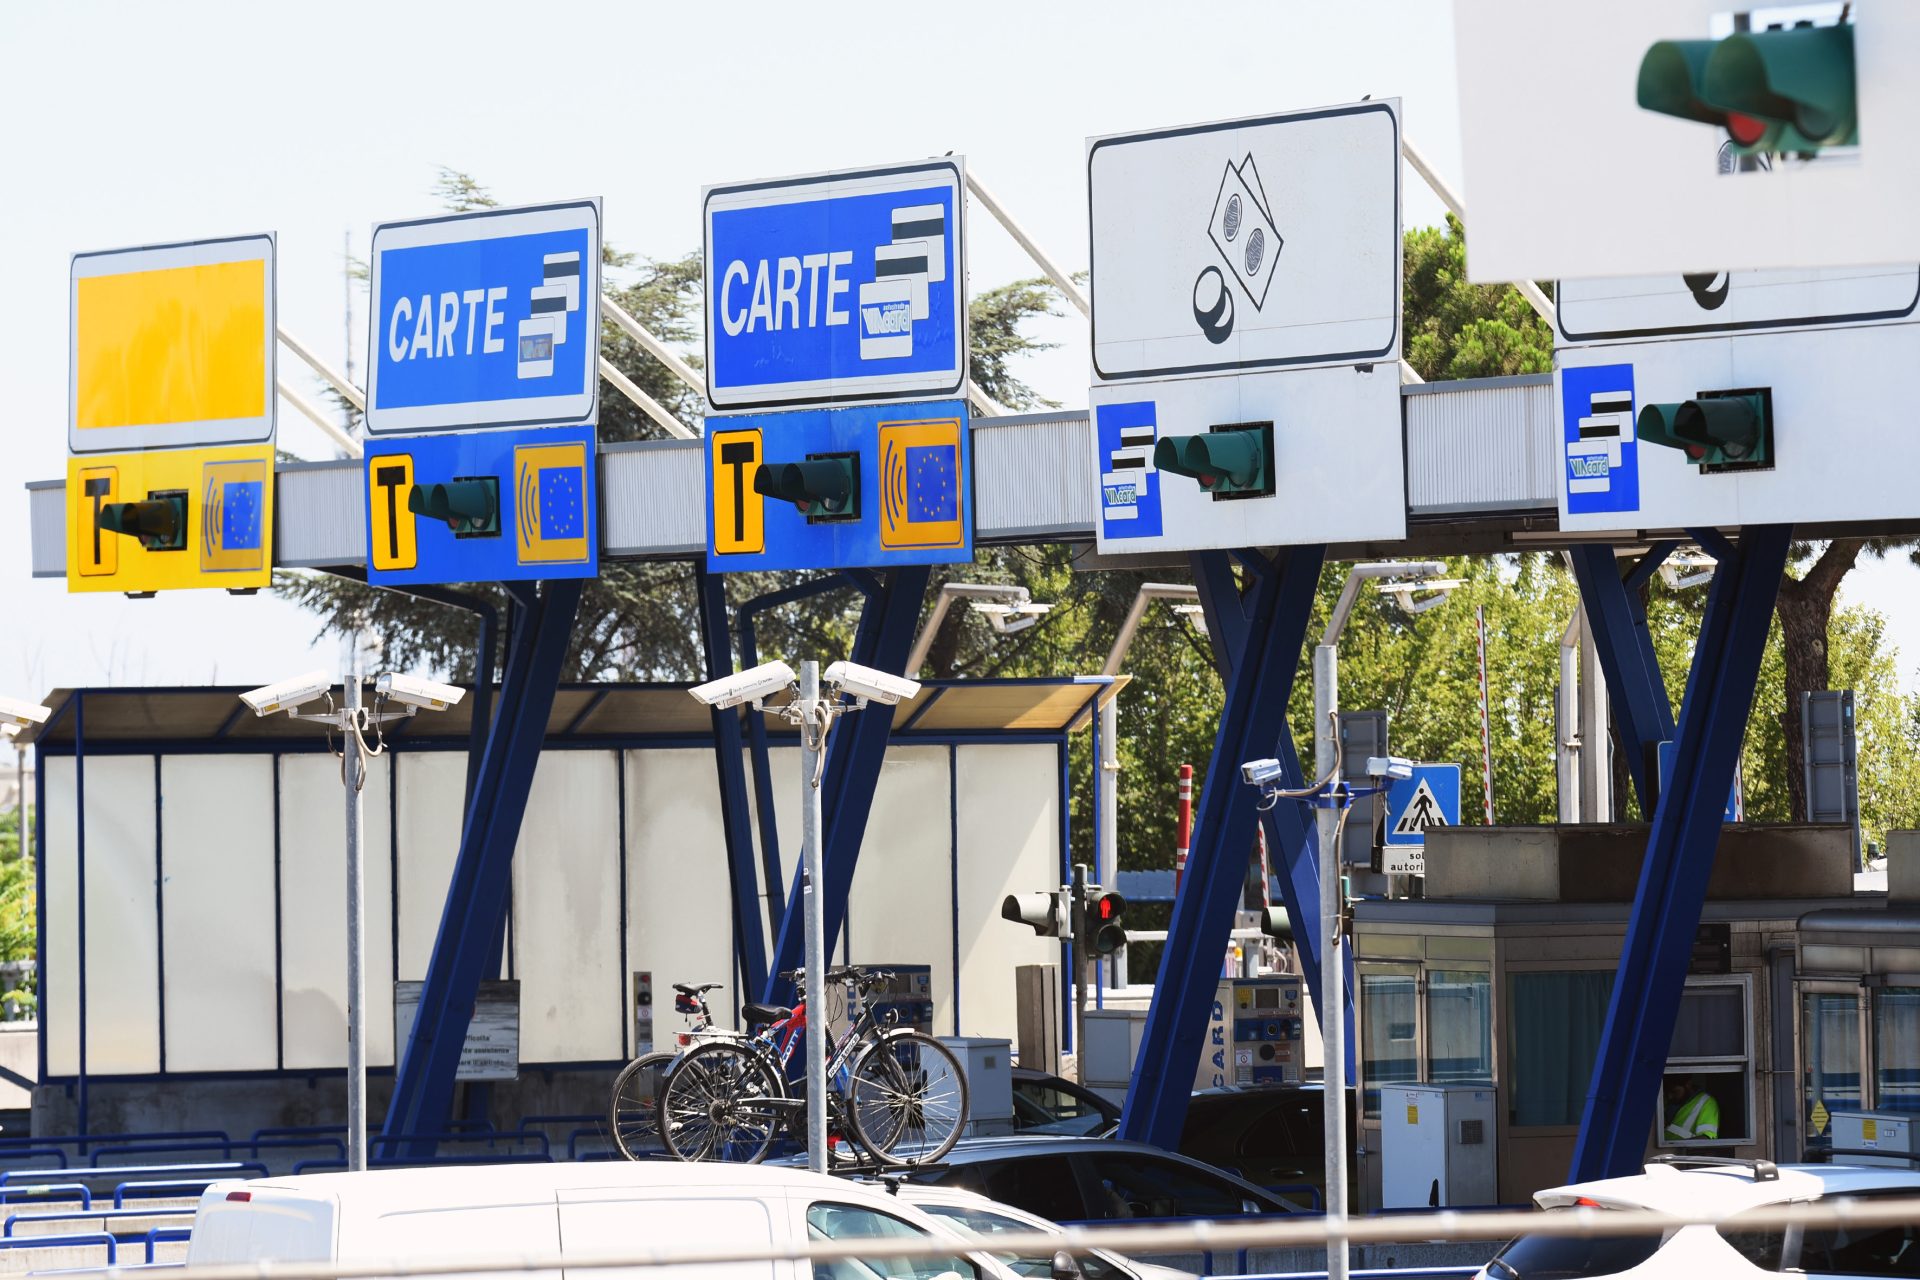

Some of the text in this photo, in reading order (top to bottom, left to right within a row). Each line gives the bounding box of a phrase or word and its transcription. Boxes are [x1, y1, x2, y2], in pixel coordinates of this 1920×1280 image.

[389, 286, 508, 362] CARTE
[717, 251, 853, 336] CARTE
[377, 466, 406, 559] T
[721, 442, 755, 542] T
[1390, 862, 1423, 871] autori
